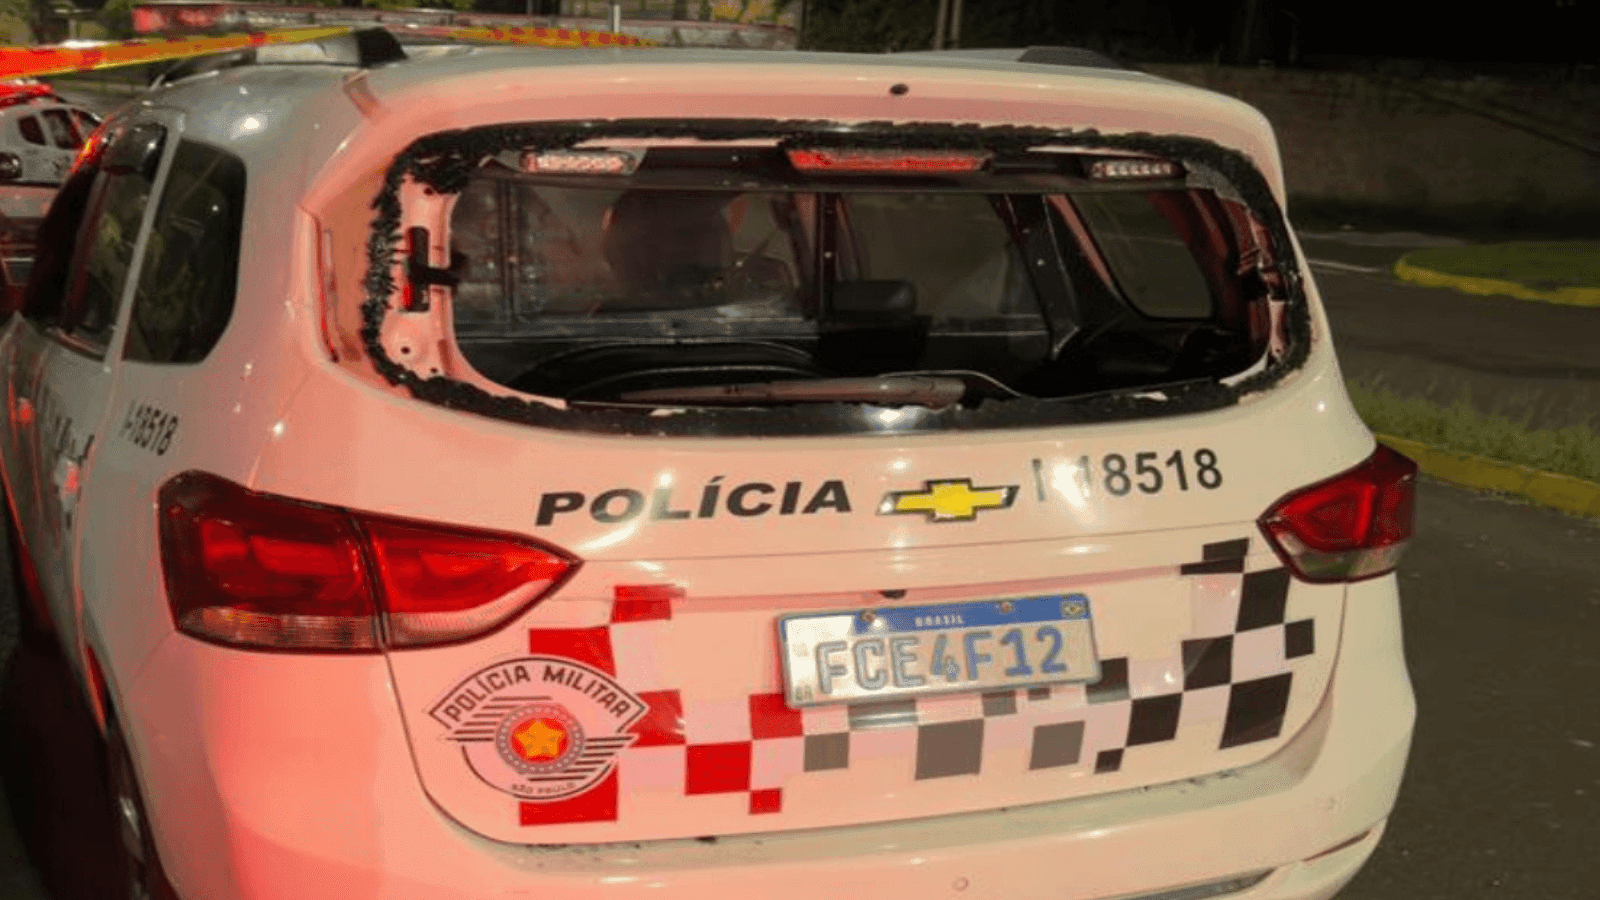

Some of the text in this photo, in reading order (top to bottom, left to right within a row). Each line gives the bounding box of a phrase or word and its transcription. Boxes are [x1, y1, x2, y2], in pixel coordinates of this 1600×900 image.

[535, 475, 852, 527] POLÍCIA
[915, 614, 964, 627] BRASIL
[815, 625, 1068, 695] FCE4F12
[443, 664, 632, 722] POLÍCIA MILITAR
